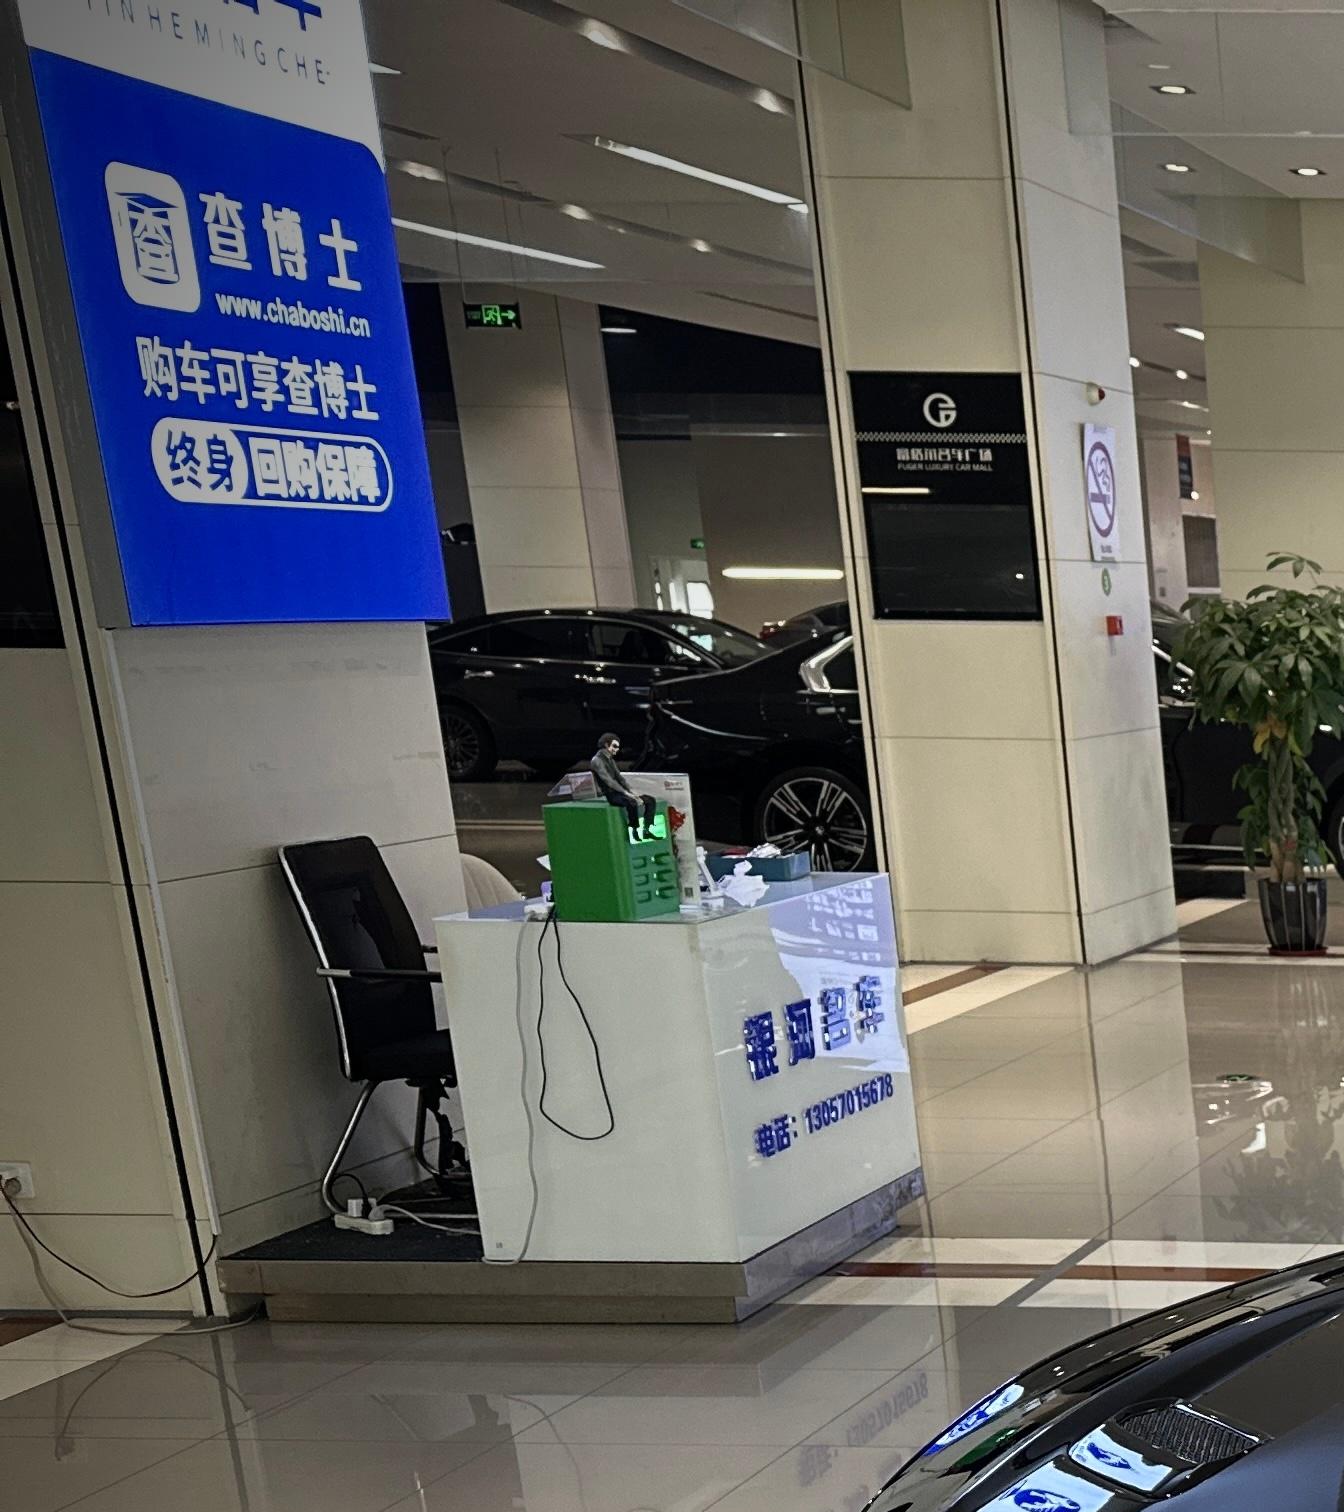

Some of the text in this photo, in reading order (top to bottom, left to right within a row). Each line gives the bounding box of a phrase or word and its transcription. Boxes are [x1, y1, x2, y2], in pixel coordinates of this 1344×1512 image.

[199, 191, 362, 291] 查博士
[215, 292, 371, 338] www.chaboshi.cn
[135, 335, 381, 421] 购车可享查博士
[165, 427, 381, 504] 终身 回购保障
